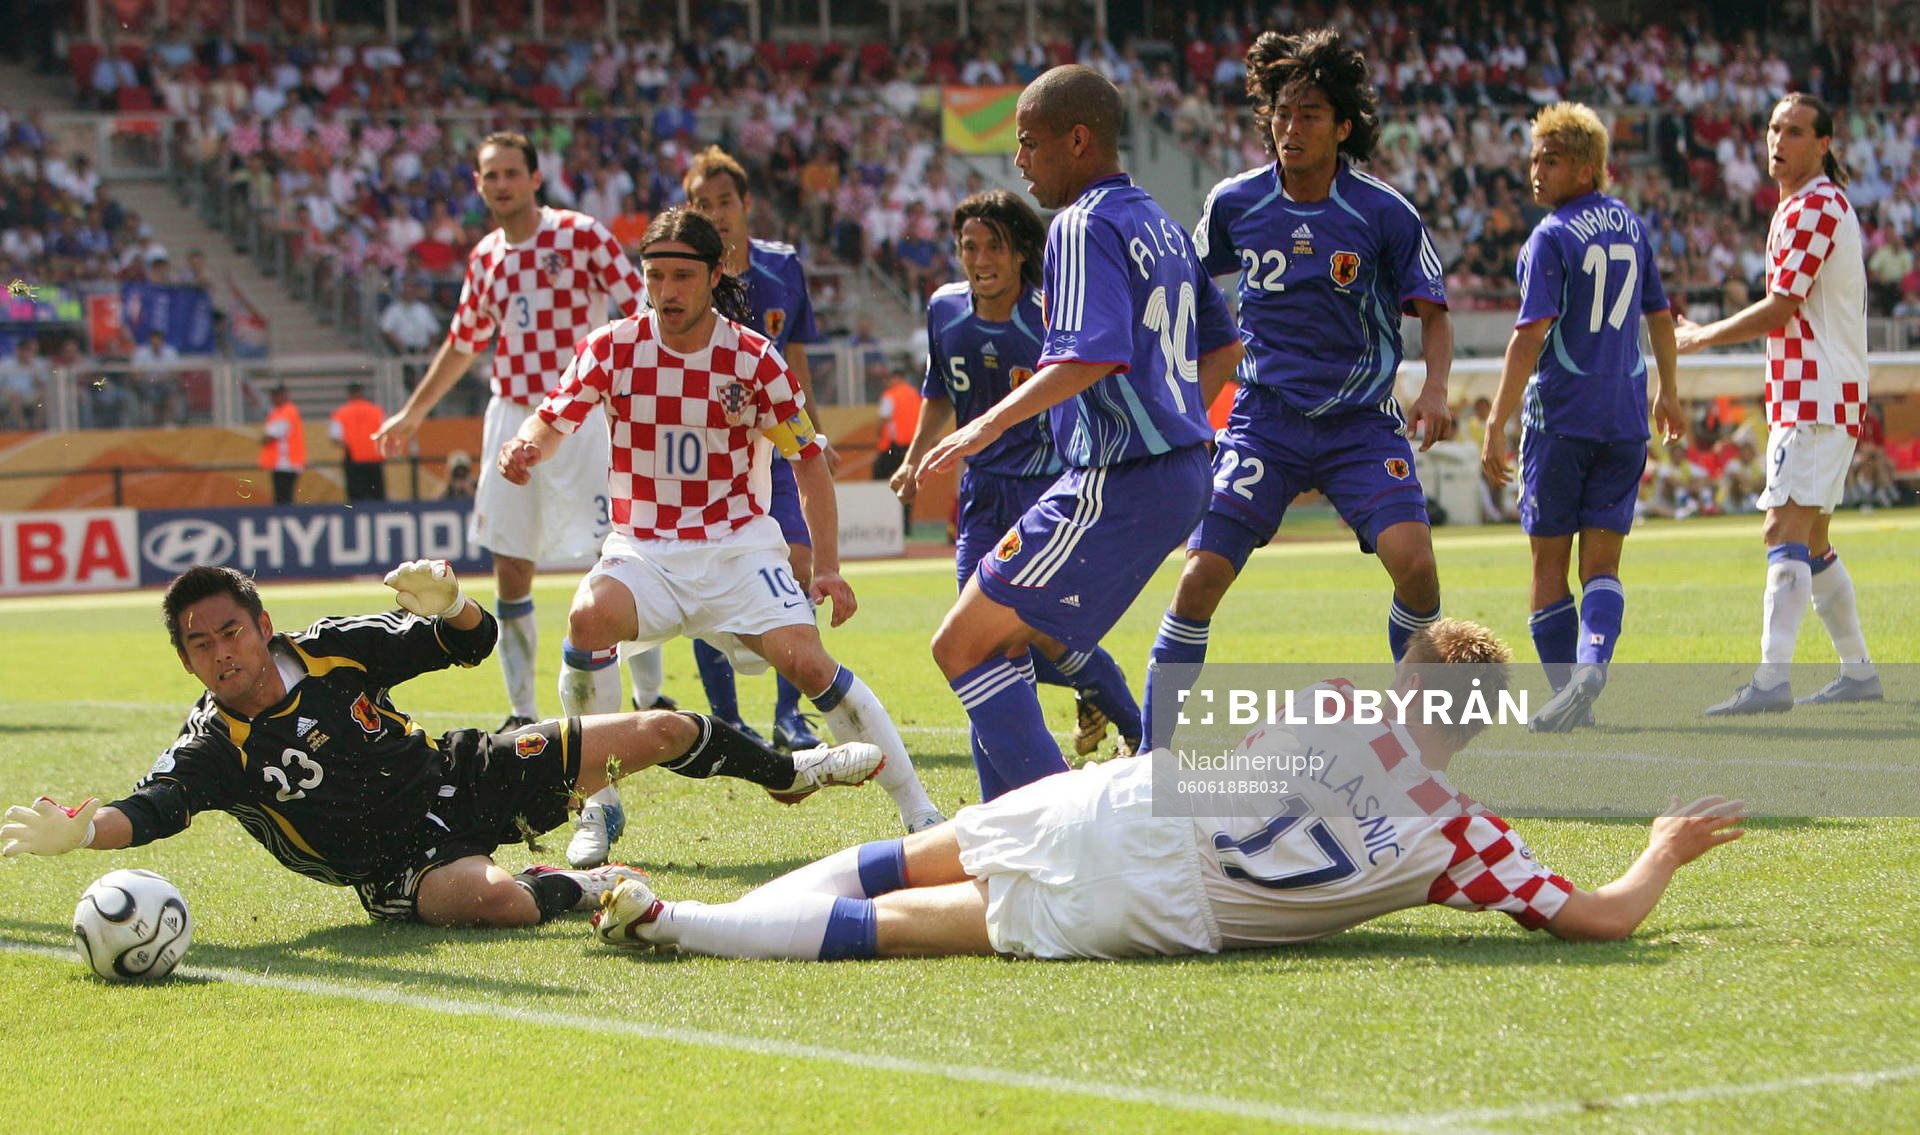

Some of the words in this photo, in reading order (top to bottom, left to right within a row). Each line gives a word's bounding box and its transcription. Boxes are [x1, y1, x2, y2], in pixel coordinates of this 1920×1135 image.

[1234, 248, 1287, 292] 22
[1582, 244, 1638, 334] 17
[516, 295, 530, 329] 3
[1142, 281, 1198, 414] 10
[950, 355, 971, 392] 5
[663, 431, 702, 476] 10
[1213, 449, 1265, 501] 22
[1774, 445, 1787, 478] 9
[594, 495, 610, 526] 3
[0, 518, 132, 586] BA
[758, 566, 800, 599] 10
[262, 747, 324, 802] 23
[1211, 793, 1362, 890] 17
